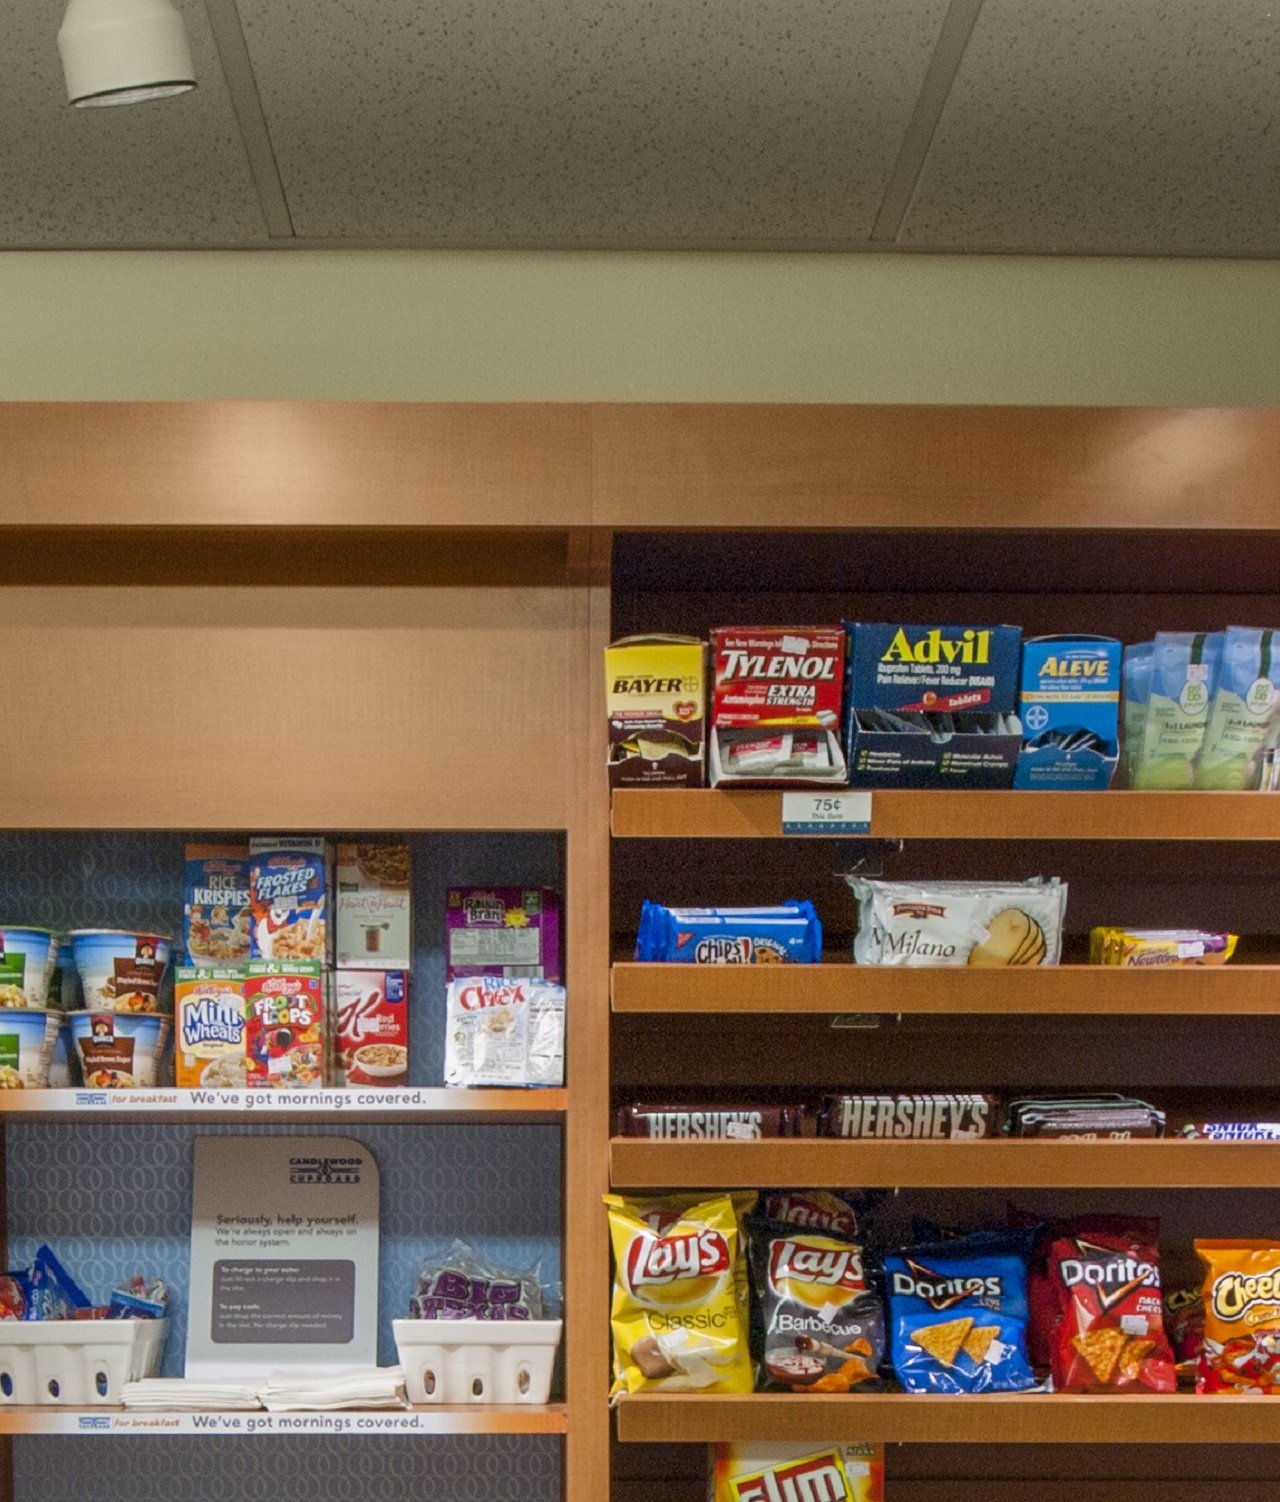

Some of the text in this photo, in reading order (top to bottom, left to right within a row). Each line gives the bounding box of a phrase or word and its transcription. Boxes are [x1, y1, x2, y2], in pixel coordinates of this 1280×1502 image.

[881, 627, 990, 664] Advil
[721, 650, 835, 680] TYLENOL
[1039, 656, 1109, 677] ALEVE
[613, 678, 682, 694] BAYER
[768, 685, 815, 698] EXTRA
[766, 696, 815, 706] STRENGTH
[948, 693, 981, 707] Tablets
[814, 799, 842, 811] 75¢
[208, 875, 237, 890] RICE
[256, 867, 315, 889] FROSTED
[194, 888, 251, 906] KRISPIES
[258, 881, 307, 900] FLAKES
[469, 909, 501, 922] Bran
[697, 937, 741, 964] Chips
[884, 929, 956, 961] Milano
[460, 985, 526, 1011] Chex
[184, 1023, 242, 1045] Wheats
[128, 1095, 178, 1104] breakfast
[190, 1091, 240, 1105] We've
[245, 1093, 272, 1109] got
[278, 1092, 352, 1109] mornings
[357, 1091, 427, 1105] covered.
[841, 1099, 989, 1138] HERSHEY'S
[289, 1158, 363, 1166] CANDLEWOOD
[289, 1175, 361, 1184] CUPBOARD
[216, 1214, 359, 1228] Seriously, help yourself.
[215, 1238, 229, 1246] the
[231, 1238, 257, 1246] honor
[243, 1228, 271, 1238] always
[273, 1229, 296, 1238] open
[297, 1228, 314, 1236] and
[316, 1228, 344, 1238] always
[632, 1229, 722, 1286] Lay's
[775, 1241, 863, 1285] Lay's
[1060, 1259, 1160, 1288] Doritos
[892, 1272, 1001, 1299] Doritos
[648, 1309, 726, 1331] Classic
[778, 1314, 862, 1336] Barbecue
[131, 1419, 180, 1428] breakfast
[192, 1415, 241, 1429] We've
[246, 1416, 274, 1432] got
[278, 1415, 352, 1432] mornings
[357, 1414, 425, 1428] covered.
